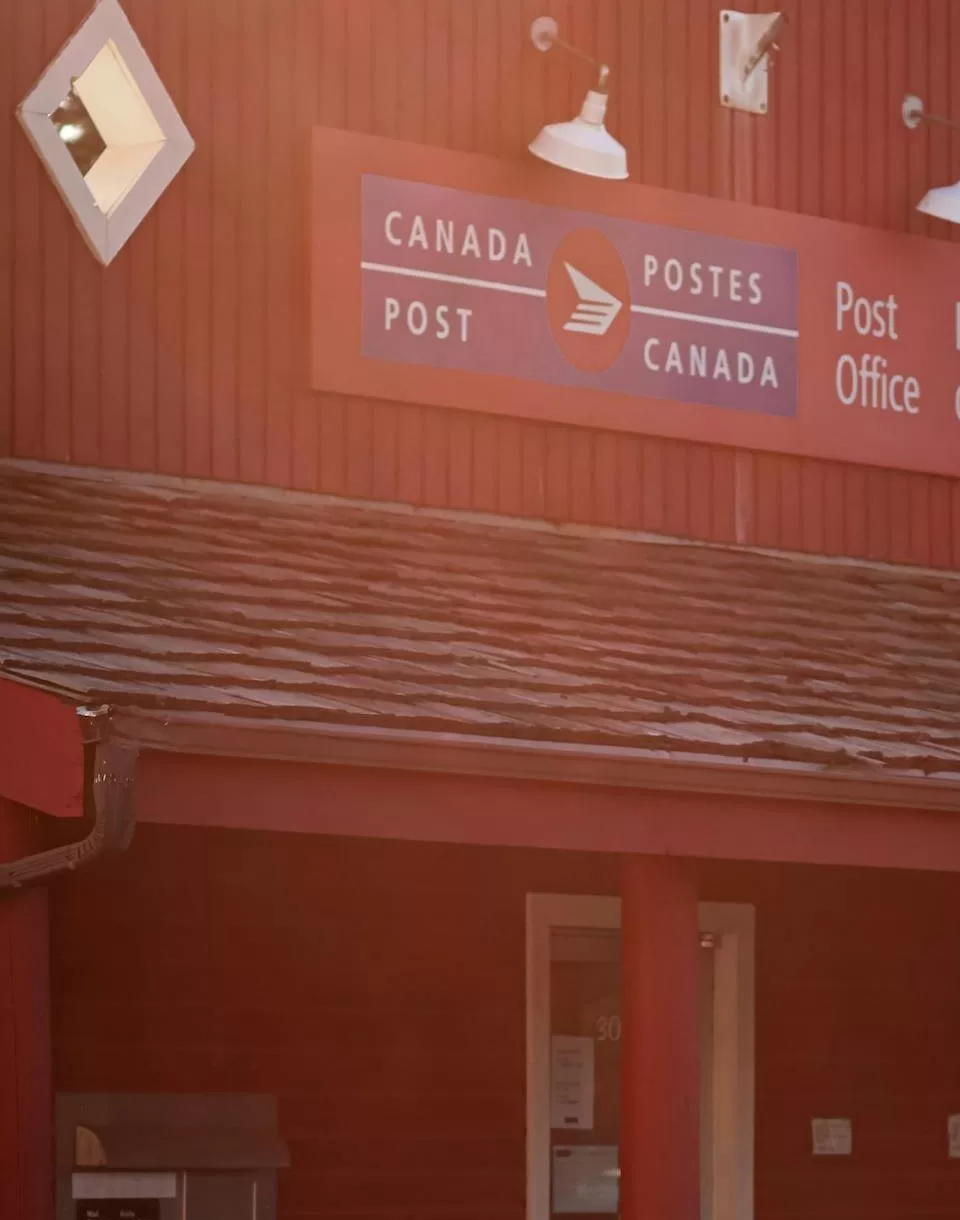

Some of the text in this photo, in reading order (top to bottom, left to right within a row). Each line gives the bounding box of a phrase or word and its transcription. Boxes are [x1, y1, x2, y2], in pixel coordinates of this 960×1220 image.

[384, 210, 533, 267] CANADA
[643, 254, 763, 304] POSTES
[384, 297, 473, 342] POST
[836, 281, 898, 340] Post
[643, 337, 779, 389] CANADA
[835, 353, 920, 414] Office
